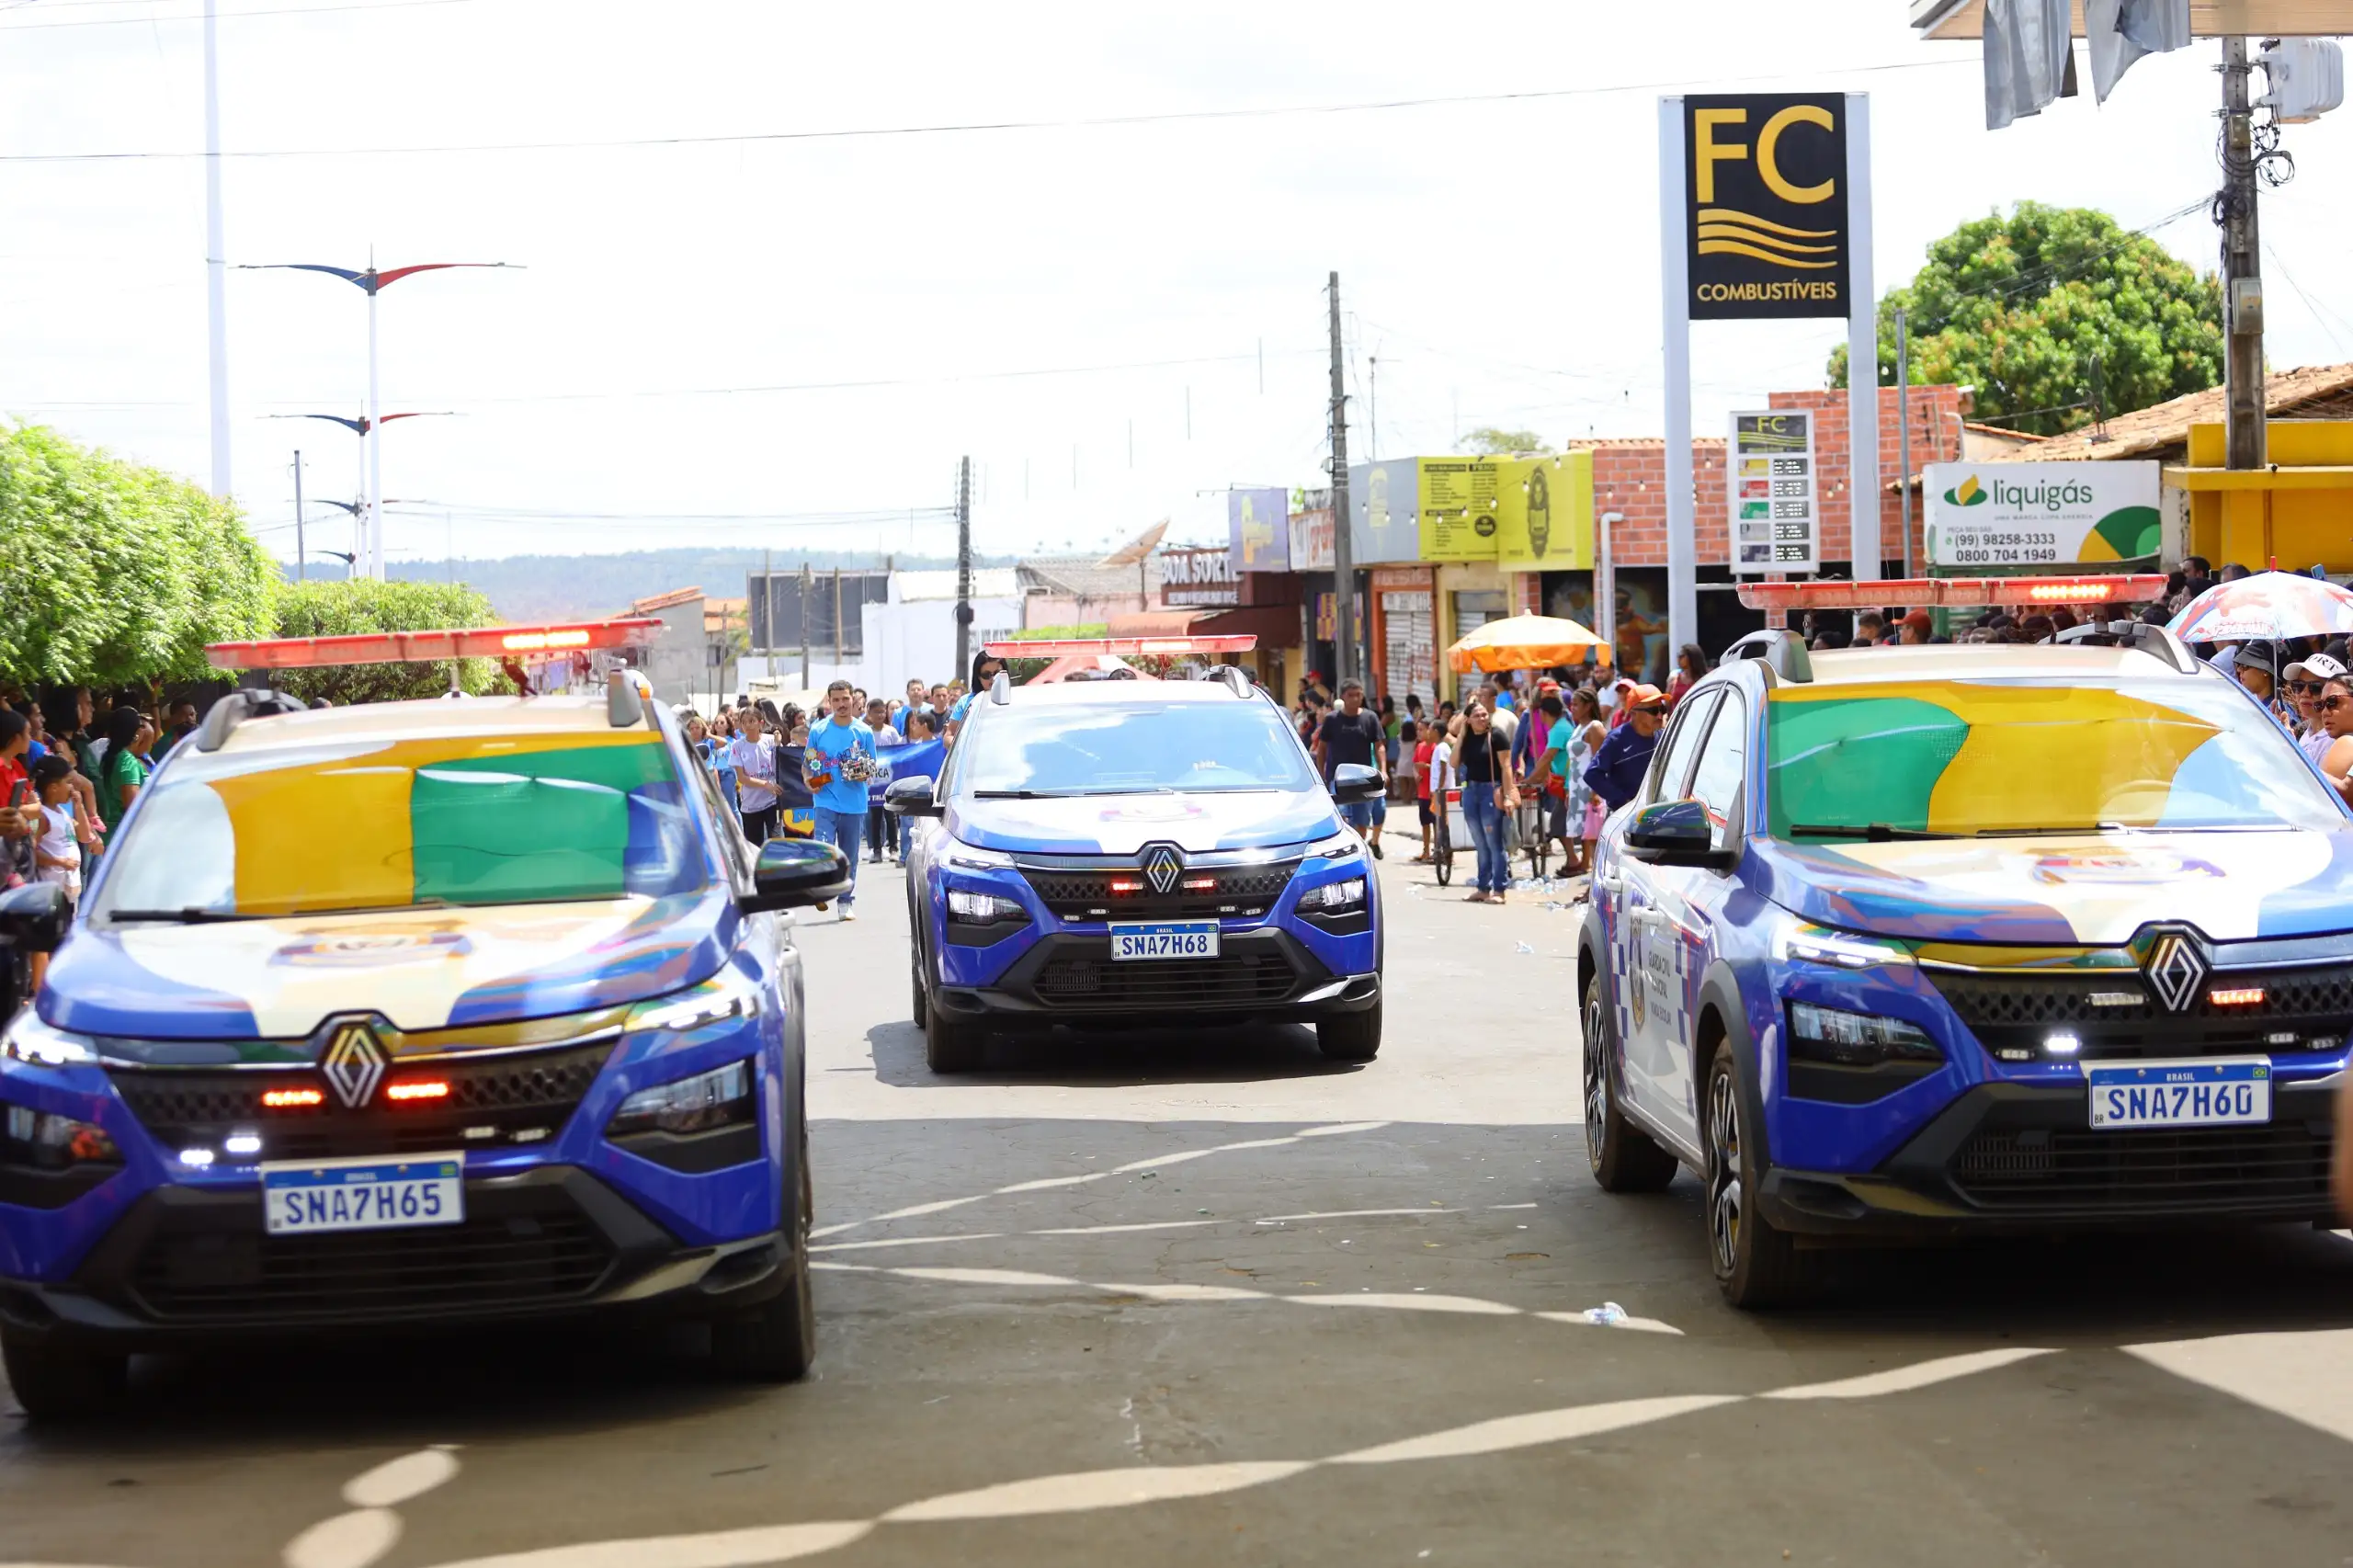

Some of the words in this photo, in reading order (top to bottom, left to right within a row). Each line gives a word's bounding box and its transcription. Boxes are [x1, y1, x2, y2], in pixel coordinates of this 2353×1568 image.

[1695, 105, 1835, 204] FC
[1697, 278, 1837, 301] COMBUSTÍVEIS
[1756, 415, 1787, 433] FC
[1993, 479, 2093, 512] liquigás
[1955, 533, 1979, 546] (99)
[1983, 533, 2055, 545] 98258-3333
[1956, 550, 1989, 562] 0800
[1995, 550, 2018, 562] 704
[2023, 549, 2056, 561] 1949
[1122, 935, 1208, 955] SNA7H68
[2166, 1073, 2195, 1082] BRASIL
[2109, 1085, 2252, 1119] SNA7H60
[2094, 1114, 2104, 1124] BR
[285, 1183, 442, 1224] SNA7H65
